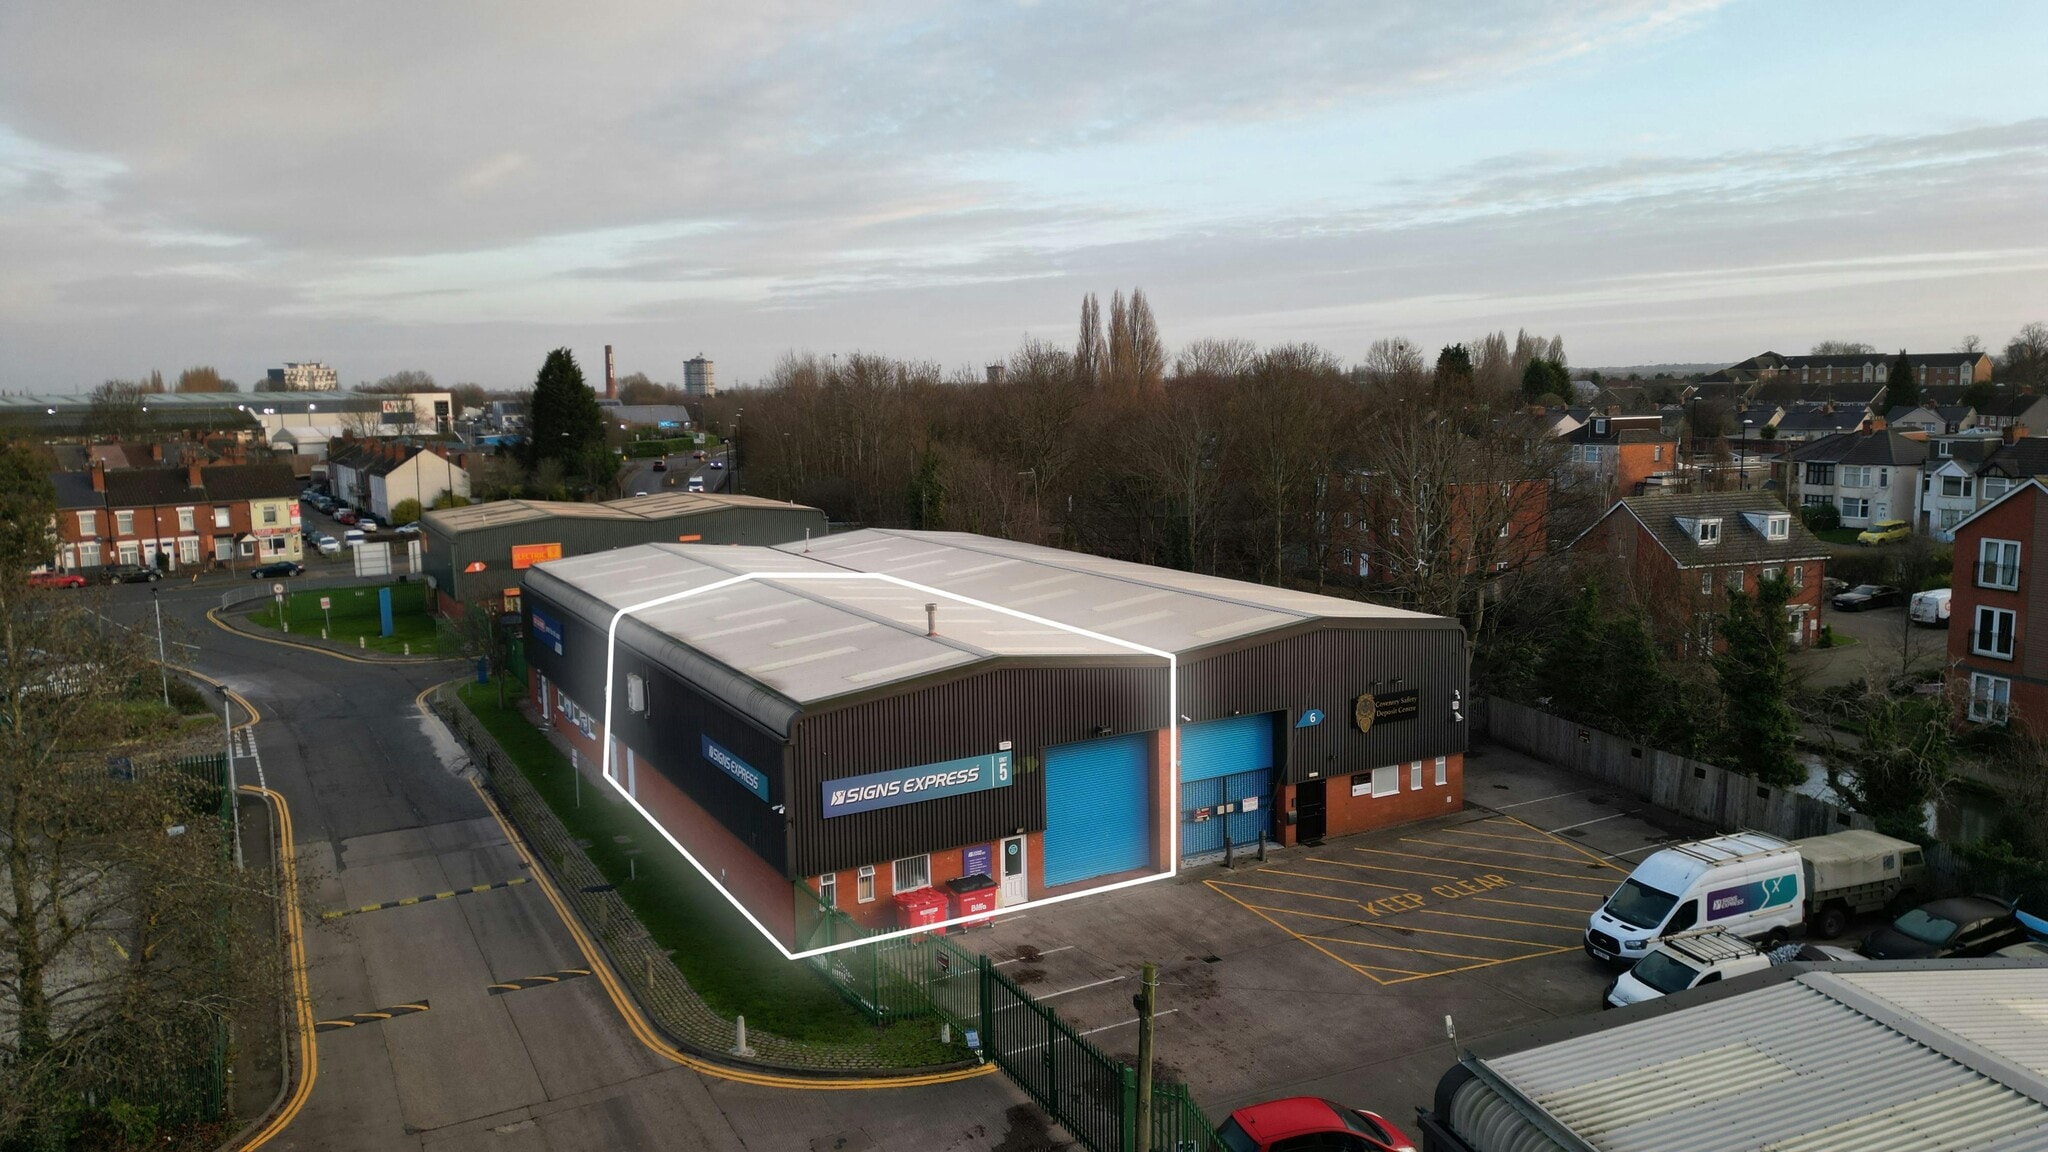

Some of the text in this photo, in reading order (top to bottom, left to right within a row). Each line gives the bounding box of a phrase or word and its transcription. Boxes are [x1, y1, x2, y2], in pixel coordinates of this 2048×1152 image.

[1375, 696, 1417, 708] Coventry Safety
[1310, 712, 1316, 723] 6
[1376, 708, 1397, 717] Deposit
[712, 749, 759, 789] SIGNS EXPRESS
[1000, 762, 1007, 781] 5
[846, 766, 980, 803] SIGNS EXPRESS
[1358, 874, 1516, 917] KEEP CLEAR
